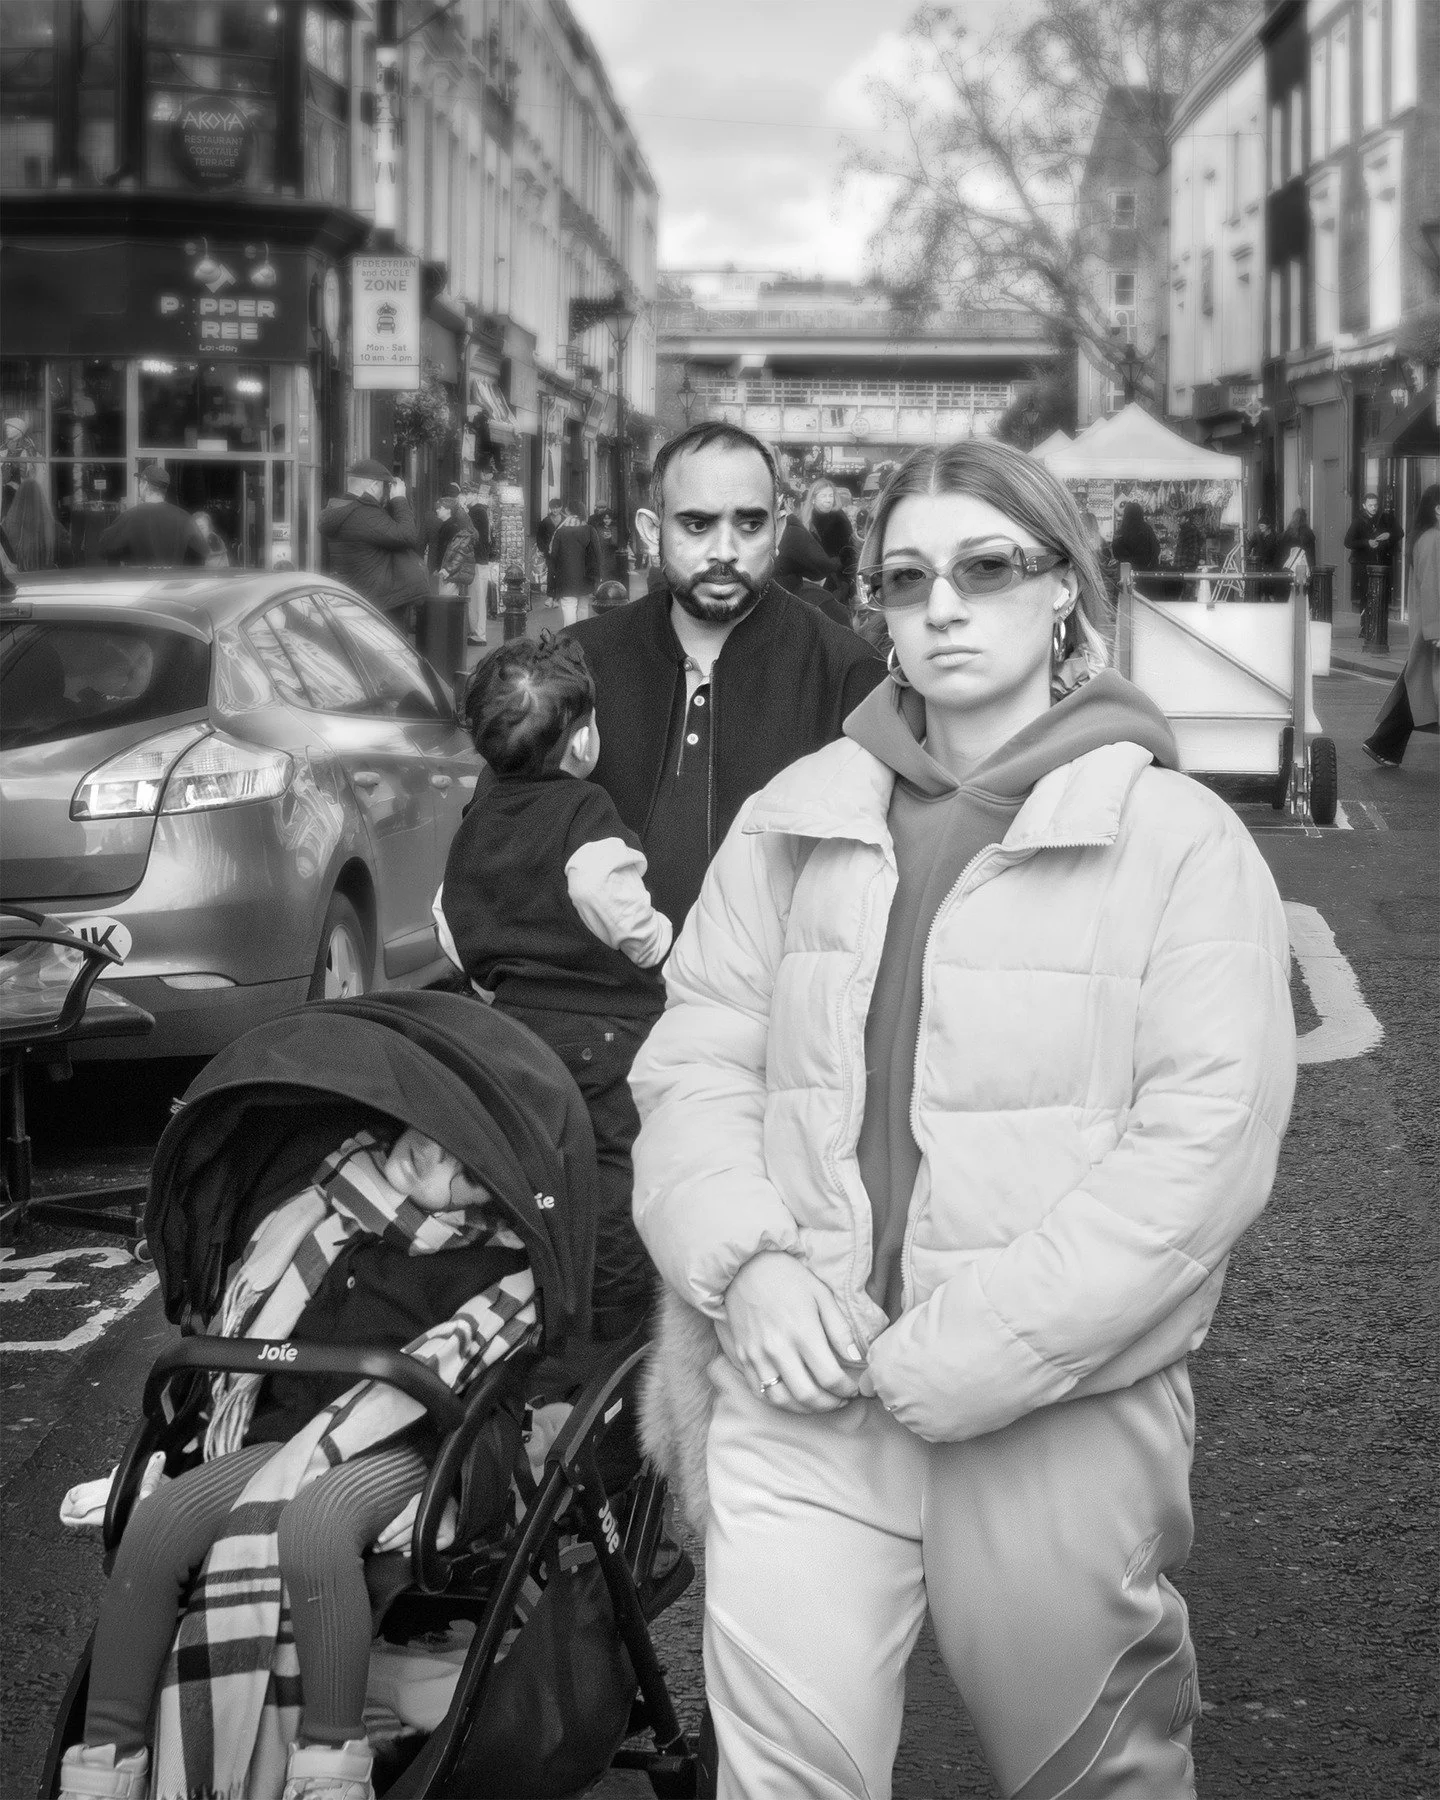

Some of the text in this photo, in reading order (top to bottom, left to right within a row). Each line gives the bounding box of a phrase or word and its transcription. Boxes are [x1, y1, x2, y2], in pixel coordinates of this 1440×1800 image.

[182, 111, 244, 131] AKOYA
[184, 134, 243, 145] RESTAURANT
[189, 146, 239, 157] COCKTAILS
[194, 158, 236, 167] TERRACE
[356, 260, 416, 268] PEDESTRIAN
[361, 269, 411, 277] and CYCLE
[364, 280, 407, 291] ZONE
[160, 296, 276, 318] PPPER
[366, 343, 385, 351] Mon
[391, 343, 408, 351] Sat
[360, 353, 371, 361] 10
[534, 1192, 555, 1209] ie
[257, 1342, 299, 1362] Joie
[598, 1499, 620, 1554] Joie
